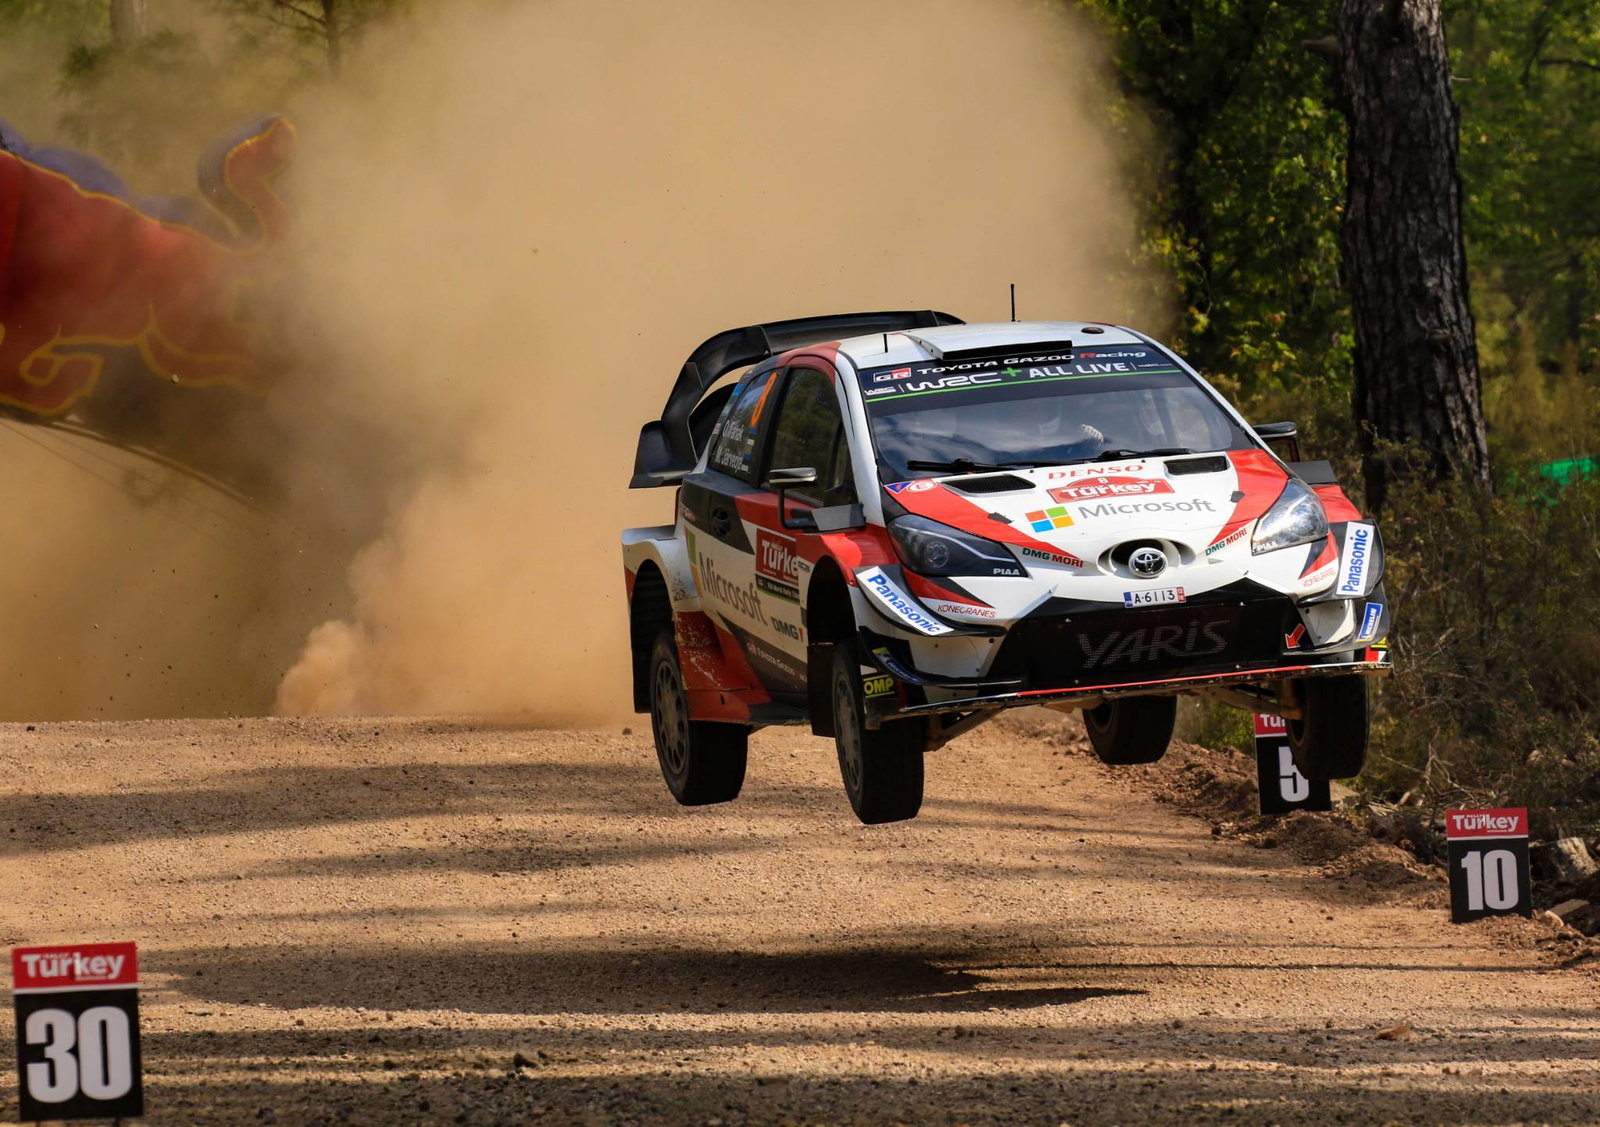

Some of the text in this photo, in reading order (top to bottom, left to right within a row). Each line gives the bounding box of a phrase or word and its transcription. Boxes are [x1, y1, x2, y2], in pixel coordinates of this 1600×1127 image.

[917, 351, 1147, 375] TOYOTA GAZOO Racing
[1029, 365, 1074, 379] ALL
[1076, 362, 1130, 375] LIVE
[1048, 464, 1143, 480] DENSO
[1078, 498, 1216, 519] Microsoft
[1205, 527, 1248, 556] DMG MORI
[1022, 547, 1085, 568] DMG MORI
[1342, 528, 1368, 593] Panasonic
[993, 567, 1020, 576] PIAA
[699, 551, 768, 627] Microsoft
[867, 573, 940, 633] Panasonic
[937, 603, 997, 619] KONECRANES
[770, 616, 800, 640] DMG
[863, 677, 894, 695] OMP
[1278, 746, 1309, 802] 5
[1460, 849, 1519, 911] 10
[25, 1005, 133, 1104] 30
